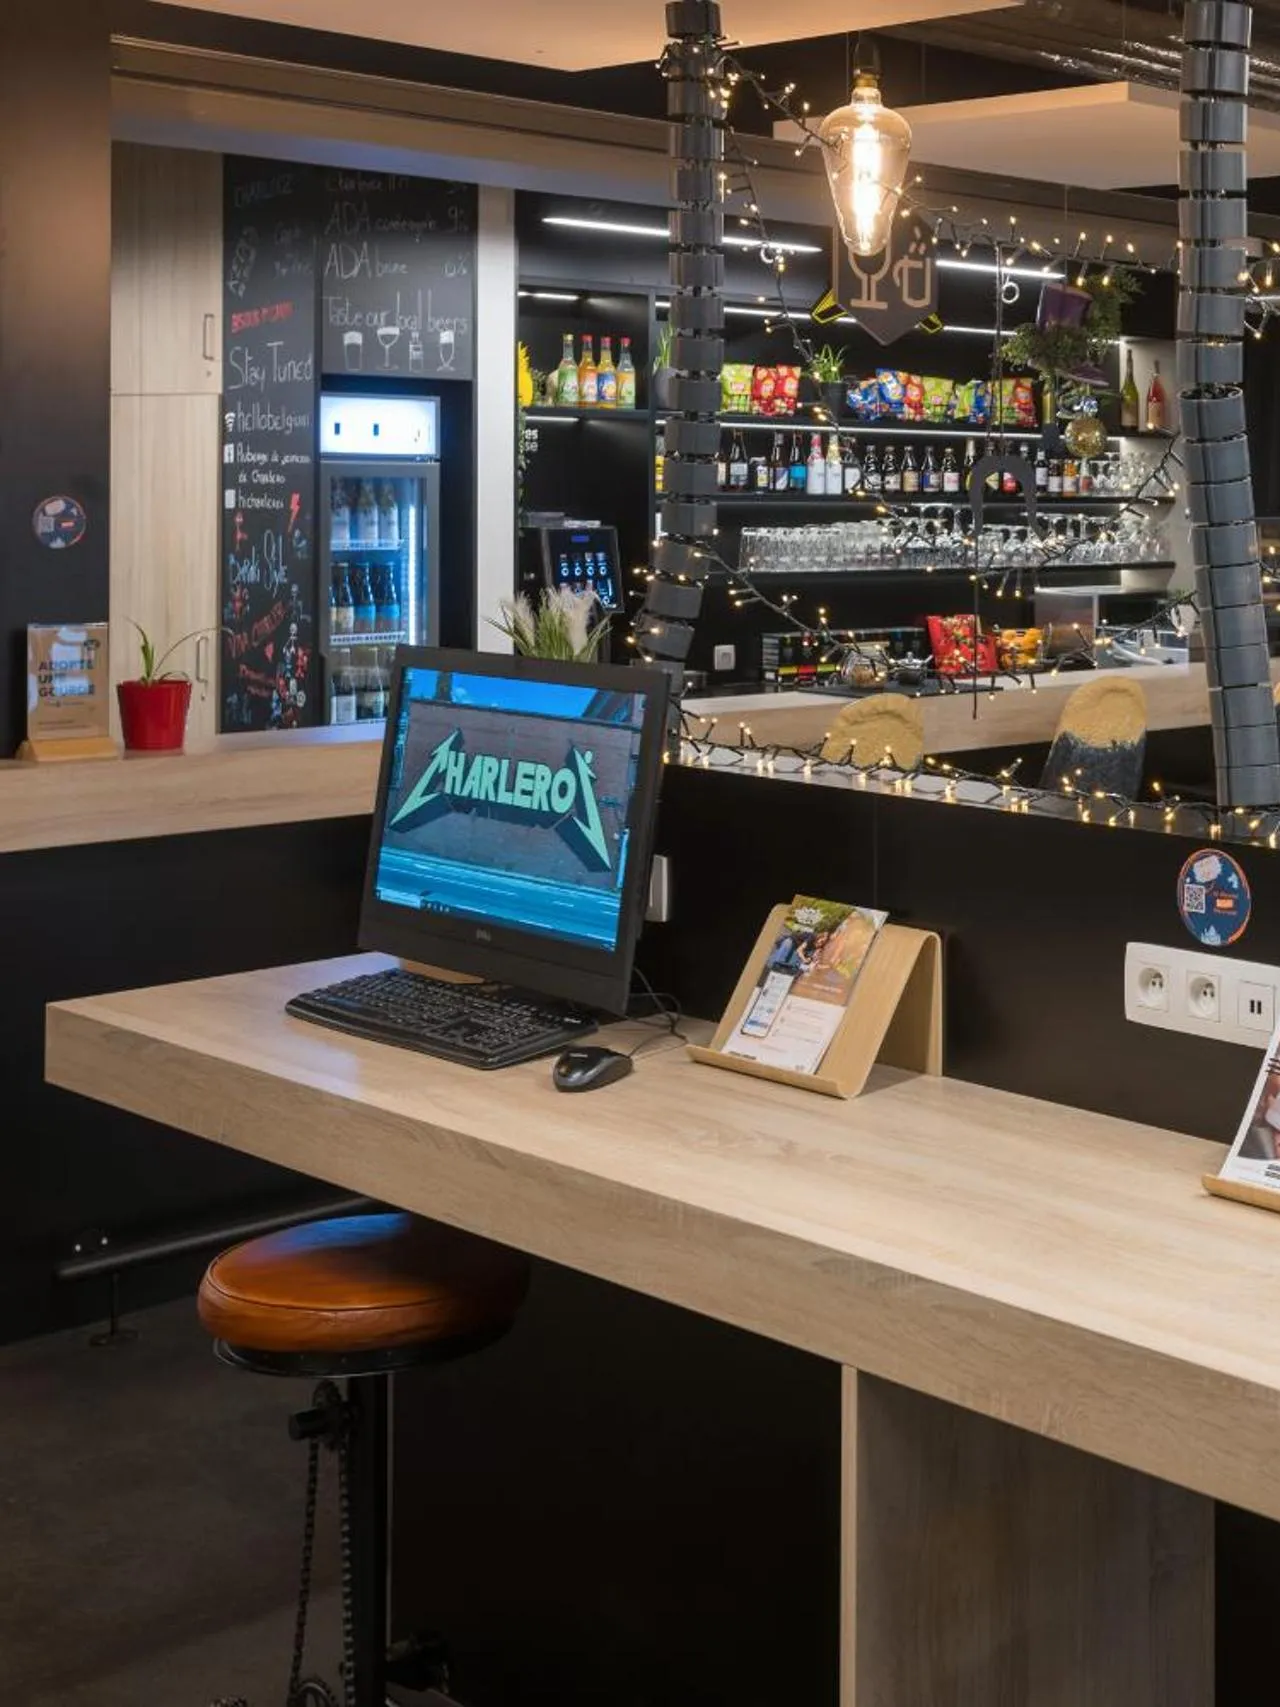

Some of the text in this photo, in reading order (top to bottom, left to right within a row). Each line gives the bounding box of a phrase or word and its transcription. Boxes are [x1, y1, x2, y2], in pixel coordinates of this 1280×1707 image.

[324, 241, 372, 279] ADA
[321, 296, 362, 328] Taste
[366, 310, 389, 327] our
[228, 341, 313, 392] Stay Tuned
[389, 729, 612, 871] CHARLEROI
